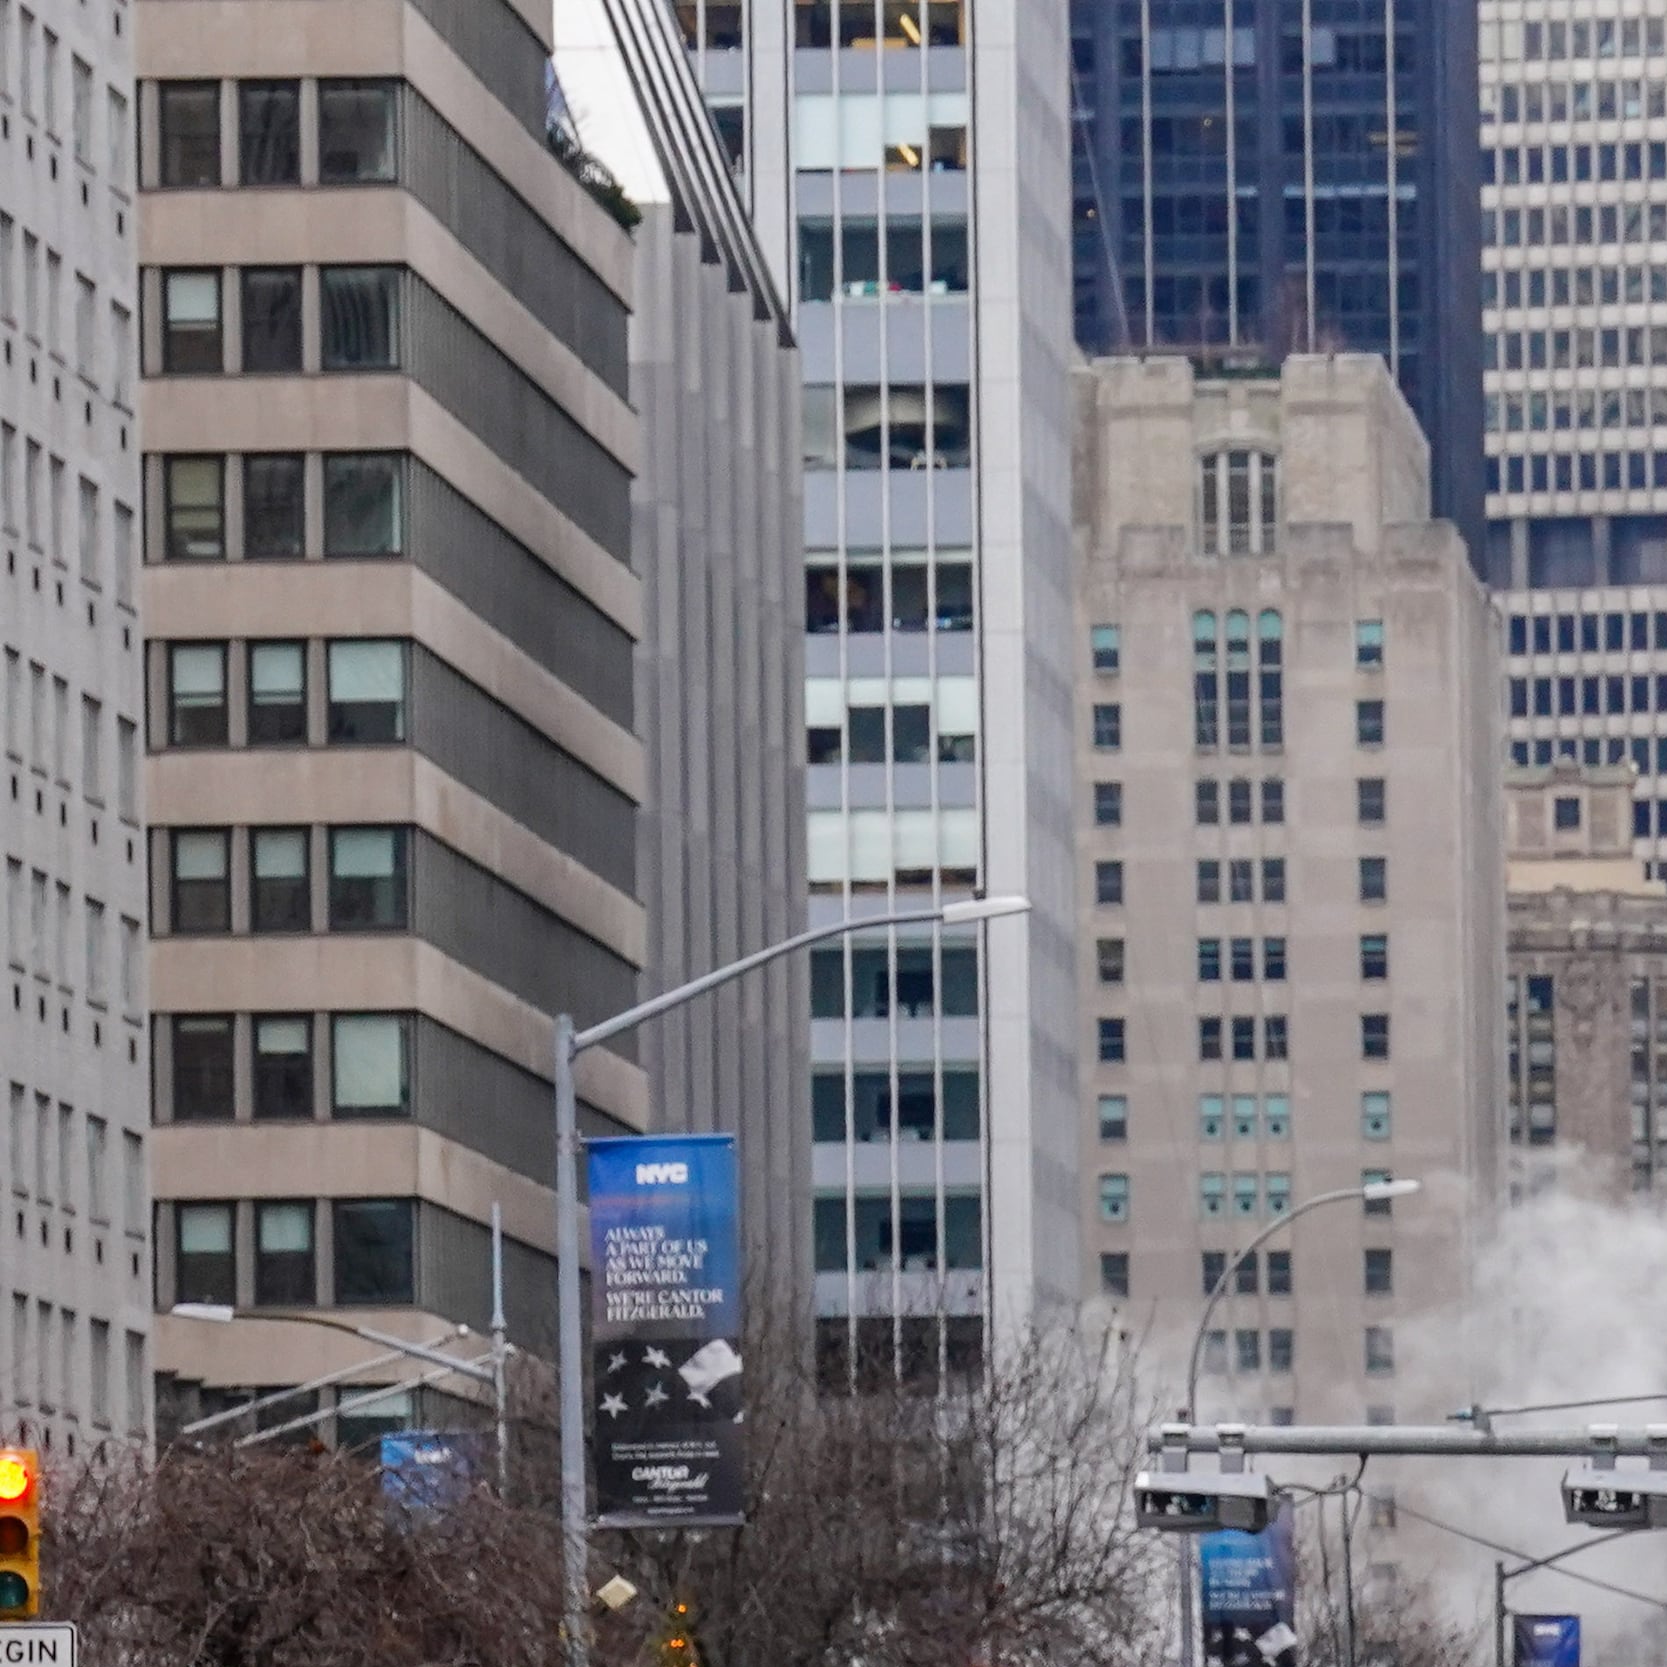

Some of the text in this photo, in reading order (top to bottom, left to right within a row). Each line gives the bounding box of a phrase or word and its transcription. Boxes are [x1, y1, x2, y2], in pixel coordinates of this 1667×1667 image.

[635, 1162, 689, 1185] NYC
[605, 1226, 665, 1241] ALWAYS
[606, 1239, 709, 1257] A PART OF US
[606, 1254, 703, 1272] AS WE MOVE
[658, 1288, 724, 1304] CANTOR
[0, 1640, 57, 1663] GIN
